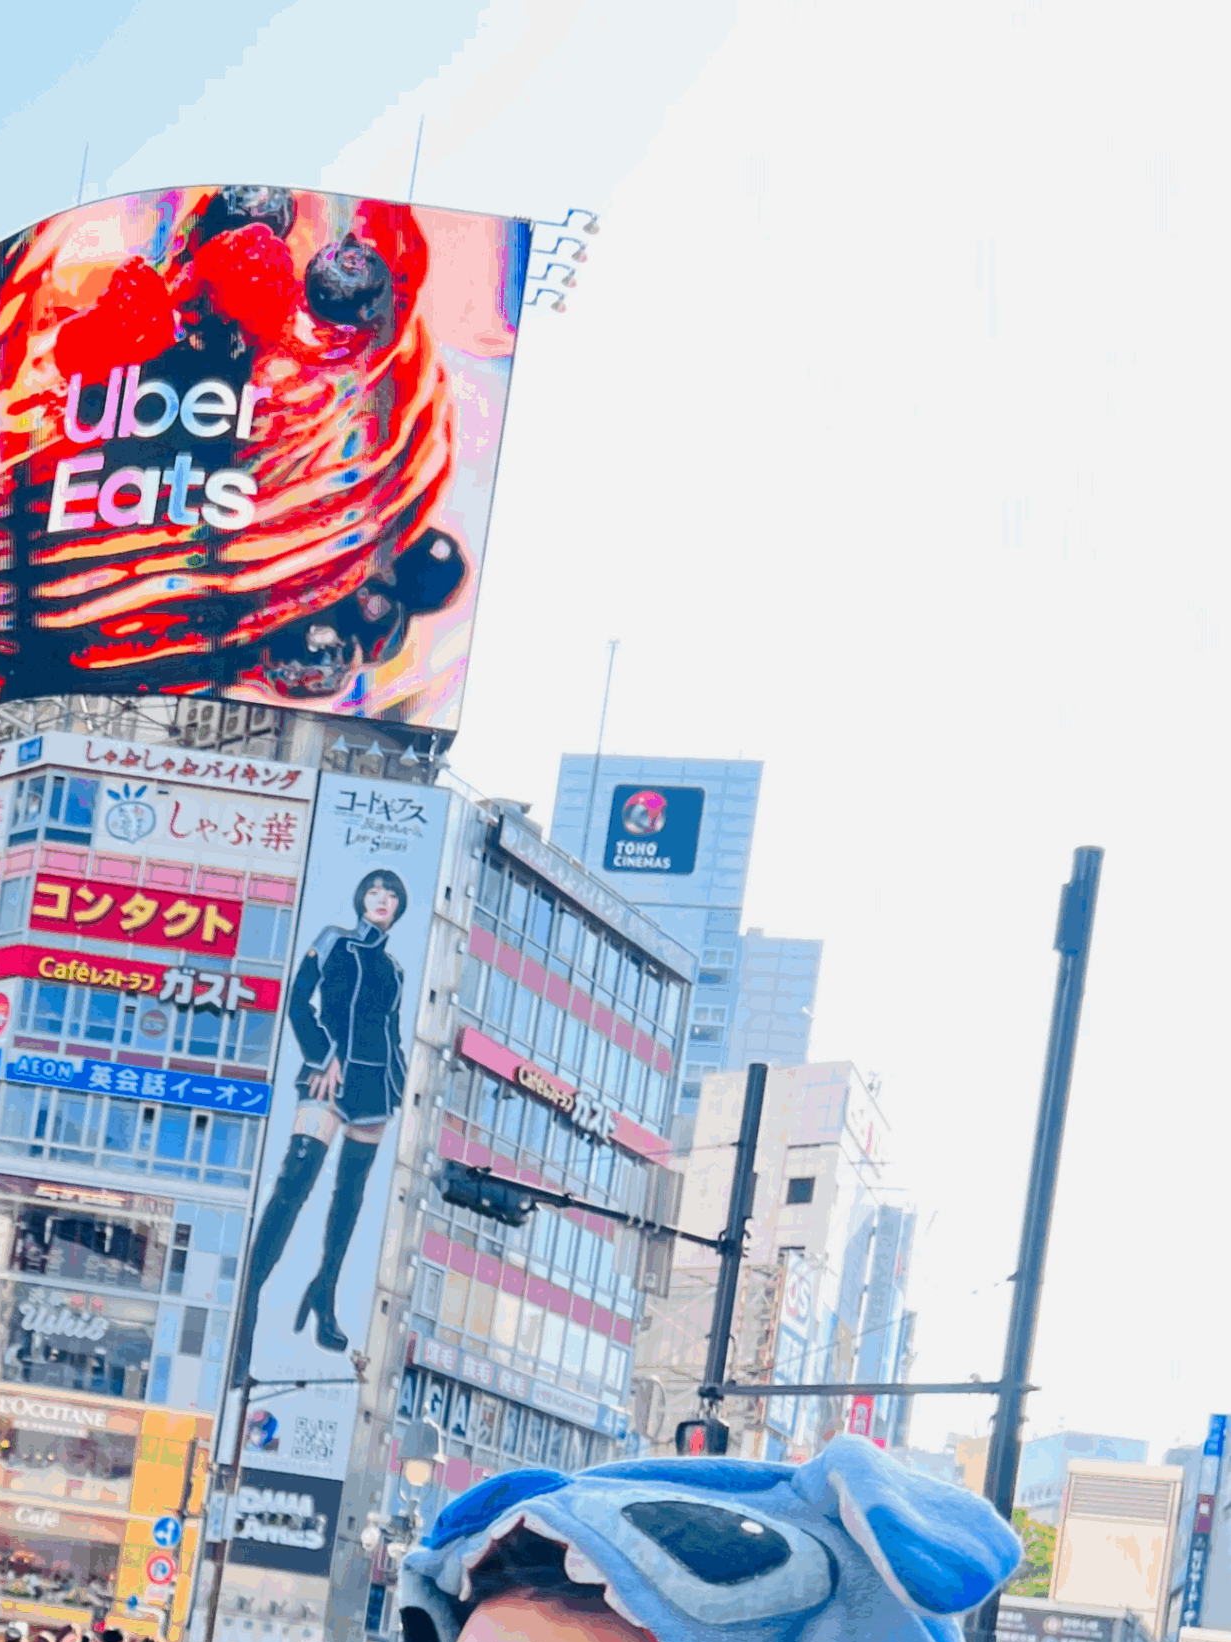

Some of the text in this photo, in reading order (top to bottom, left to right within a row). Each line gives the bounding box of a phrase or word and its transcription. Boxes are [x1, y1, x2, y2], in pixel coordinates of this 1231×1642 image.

[64, 366, 271, 443] Uber
[46, 452, 260, 533] Eats
[169, 801, 298, 852] しゃぶ葉
[615, 840, 659, 856] TOHO
[613, 855, 671, 869] CINEMAS
[30, 882, 234, 943] コンタクト
[159, 968, 256, 1011] ガスト
[16, 1057, 264, 1108] AEON 英会話イーオン
